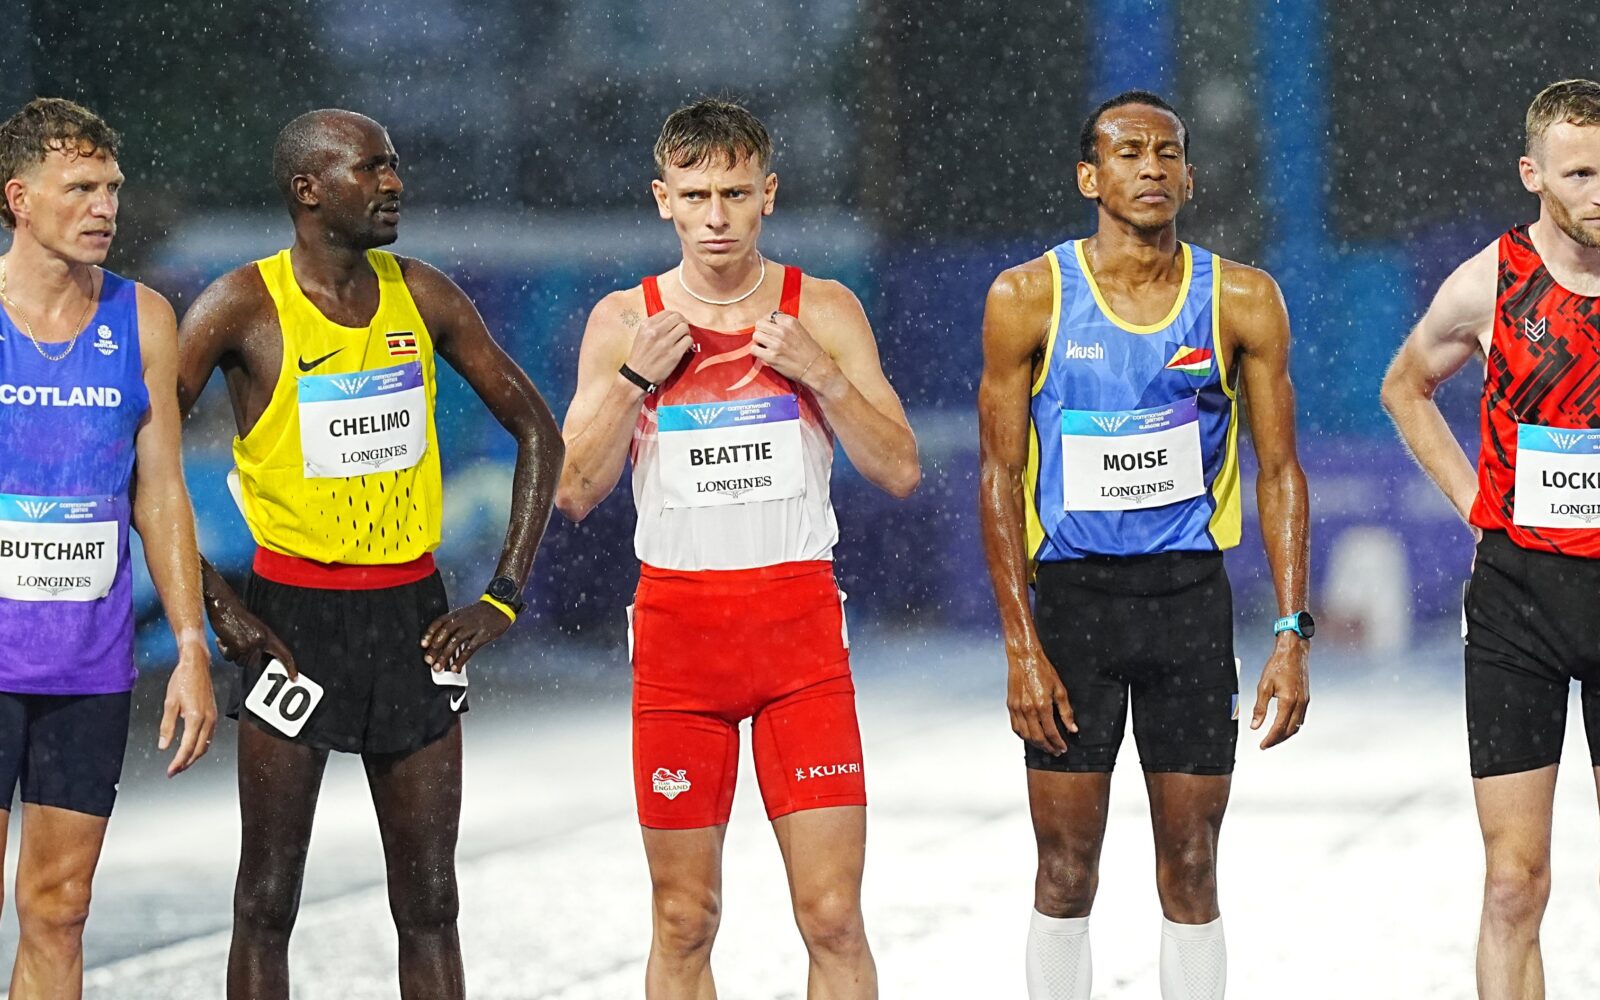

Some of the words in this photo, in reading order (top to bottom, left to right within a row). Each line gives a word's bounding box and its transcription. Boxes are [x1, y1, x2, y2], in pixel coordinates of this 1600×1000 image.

[1066, 339, 1104, 360] krush
[0, 383, 122, 408] COTLAND
[727, 401, 771, 412] commonwealth
[739, 408, 761, 417] games
[1132, 408, 1174, 421] commonwealth
[329, 409, 410, 438] CHELIMO
[1144, 416, 1165, 425] games
[341, 444, 408, 464] LONGINES
[689, 441, 773, 467] BEATTIE
[1103, 448, 1169, 472] MOISE
[696, 475, 773, 493] LONGINES
[1100, 480, 1175, 497] LONGINES
[1542, 469, 1600, 490] LOCK
[1550, 503, 1600, 515] LONGI
[0, 539, 105, 560] BUTCHART
[16, 575, 92, 588] LONGINES
[262, 672, 311, 722] 10
[808, 762, 861, 779] KUKRI
[654, 784, 689, 792] ENGLAND
